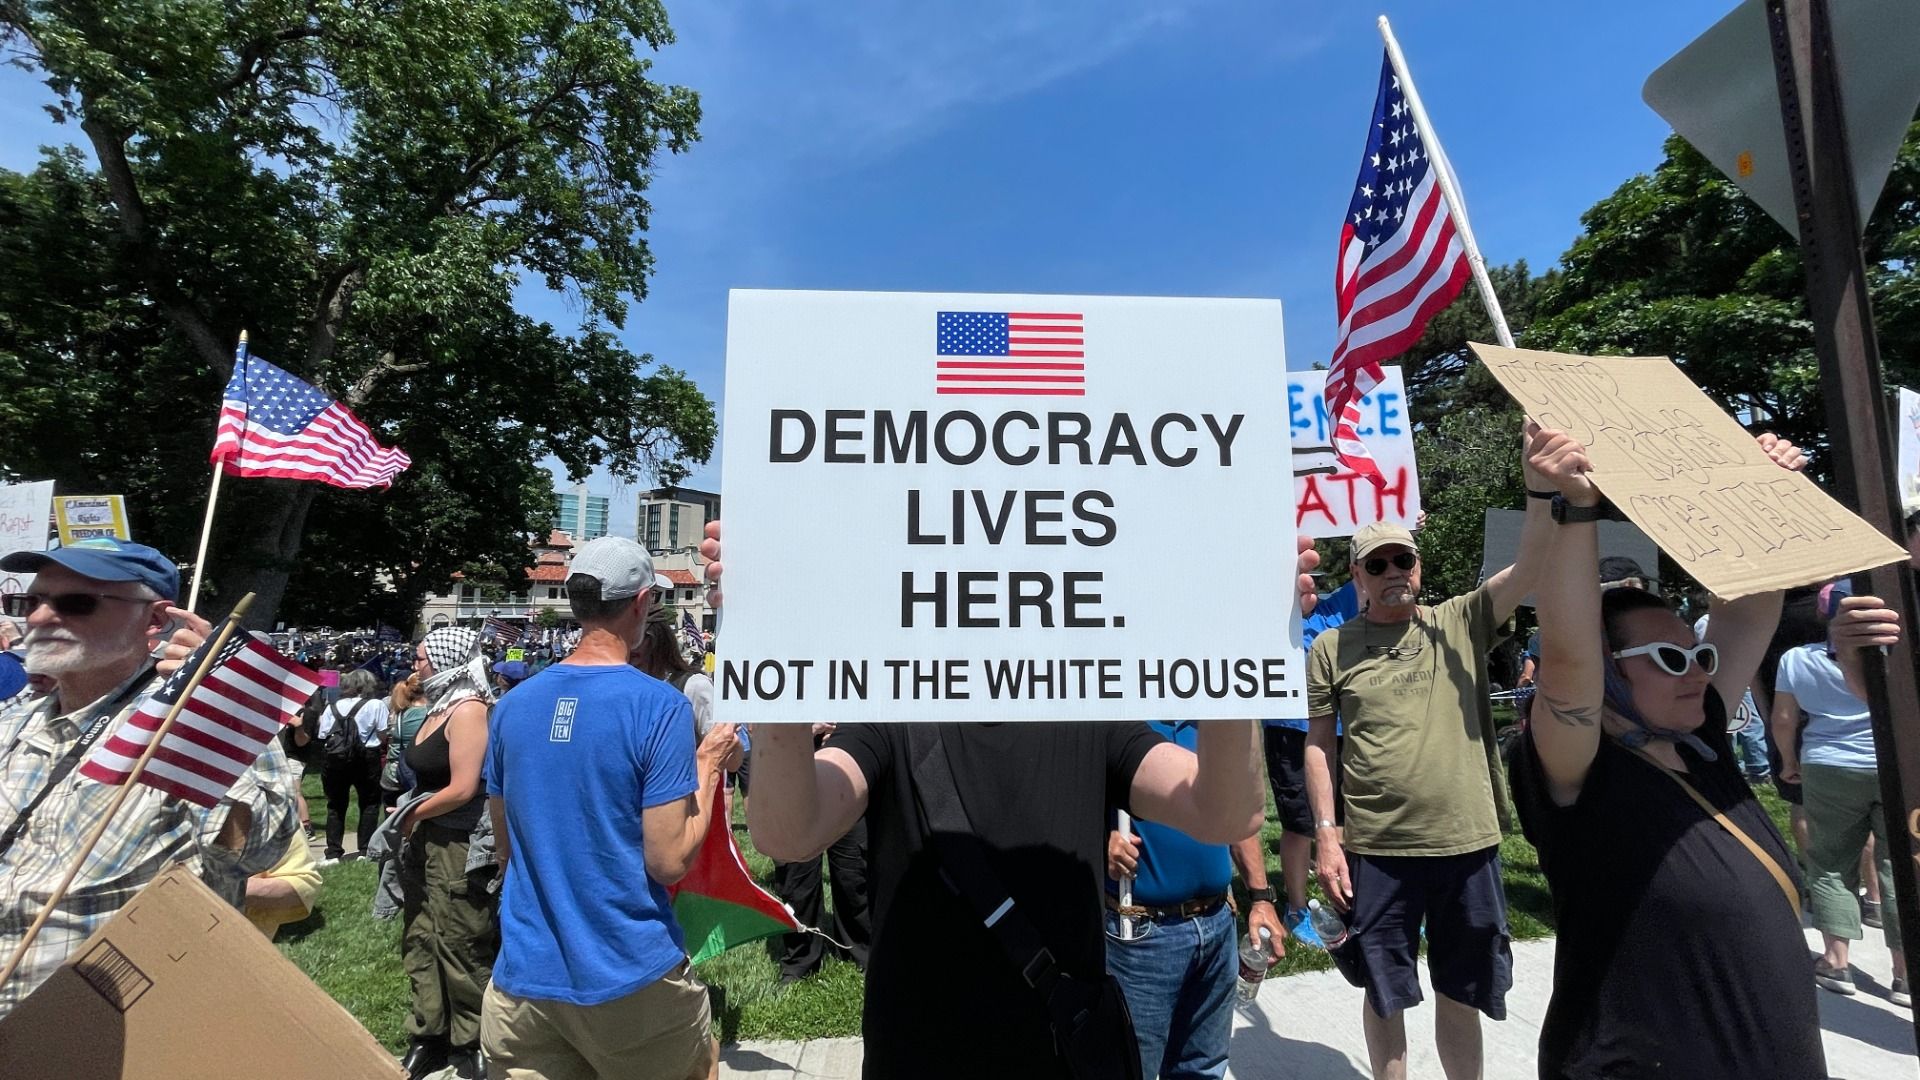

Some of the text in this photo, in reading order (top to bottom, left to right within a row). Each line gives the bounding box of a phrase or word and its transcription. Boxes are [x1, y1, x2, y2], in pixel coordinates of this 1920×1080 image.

[770, 410, 1245, 467] DEMOCRACY
[908, 490, 1117, 546] LIVES
[1699, 477, 1843, 553] NEXT
[902, 572, 1125, 628] HERE.
[723, 659, 1298, 700] NOT IN THE WHITE HOUSE.
[555, 725, 569, 738] TEN
[558, 701, 574, 716] BIG
